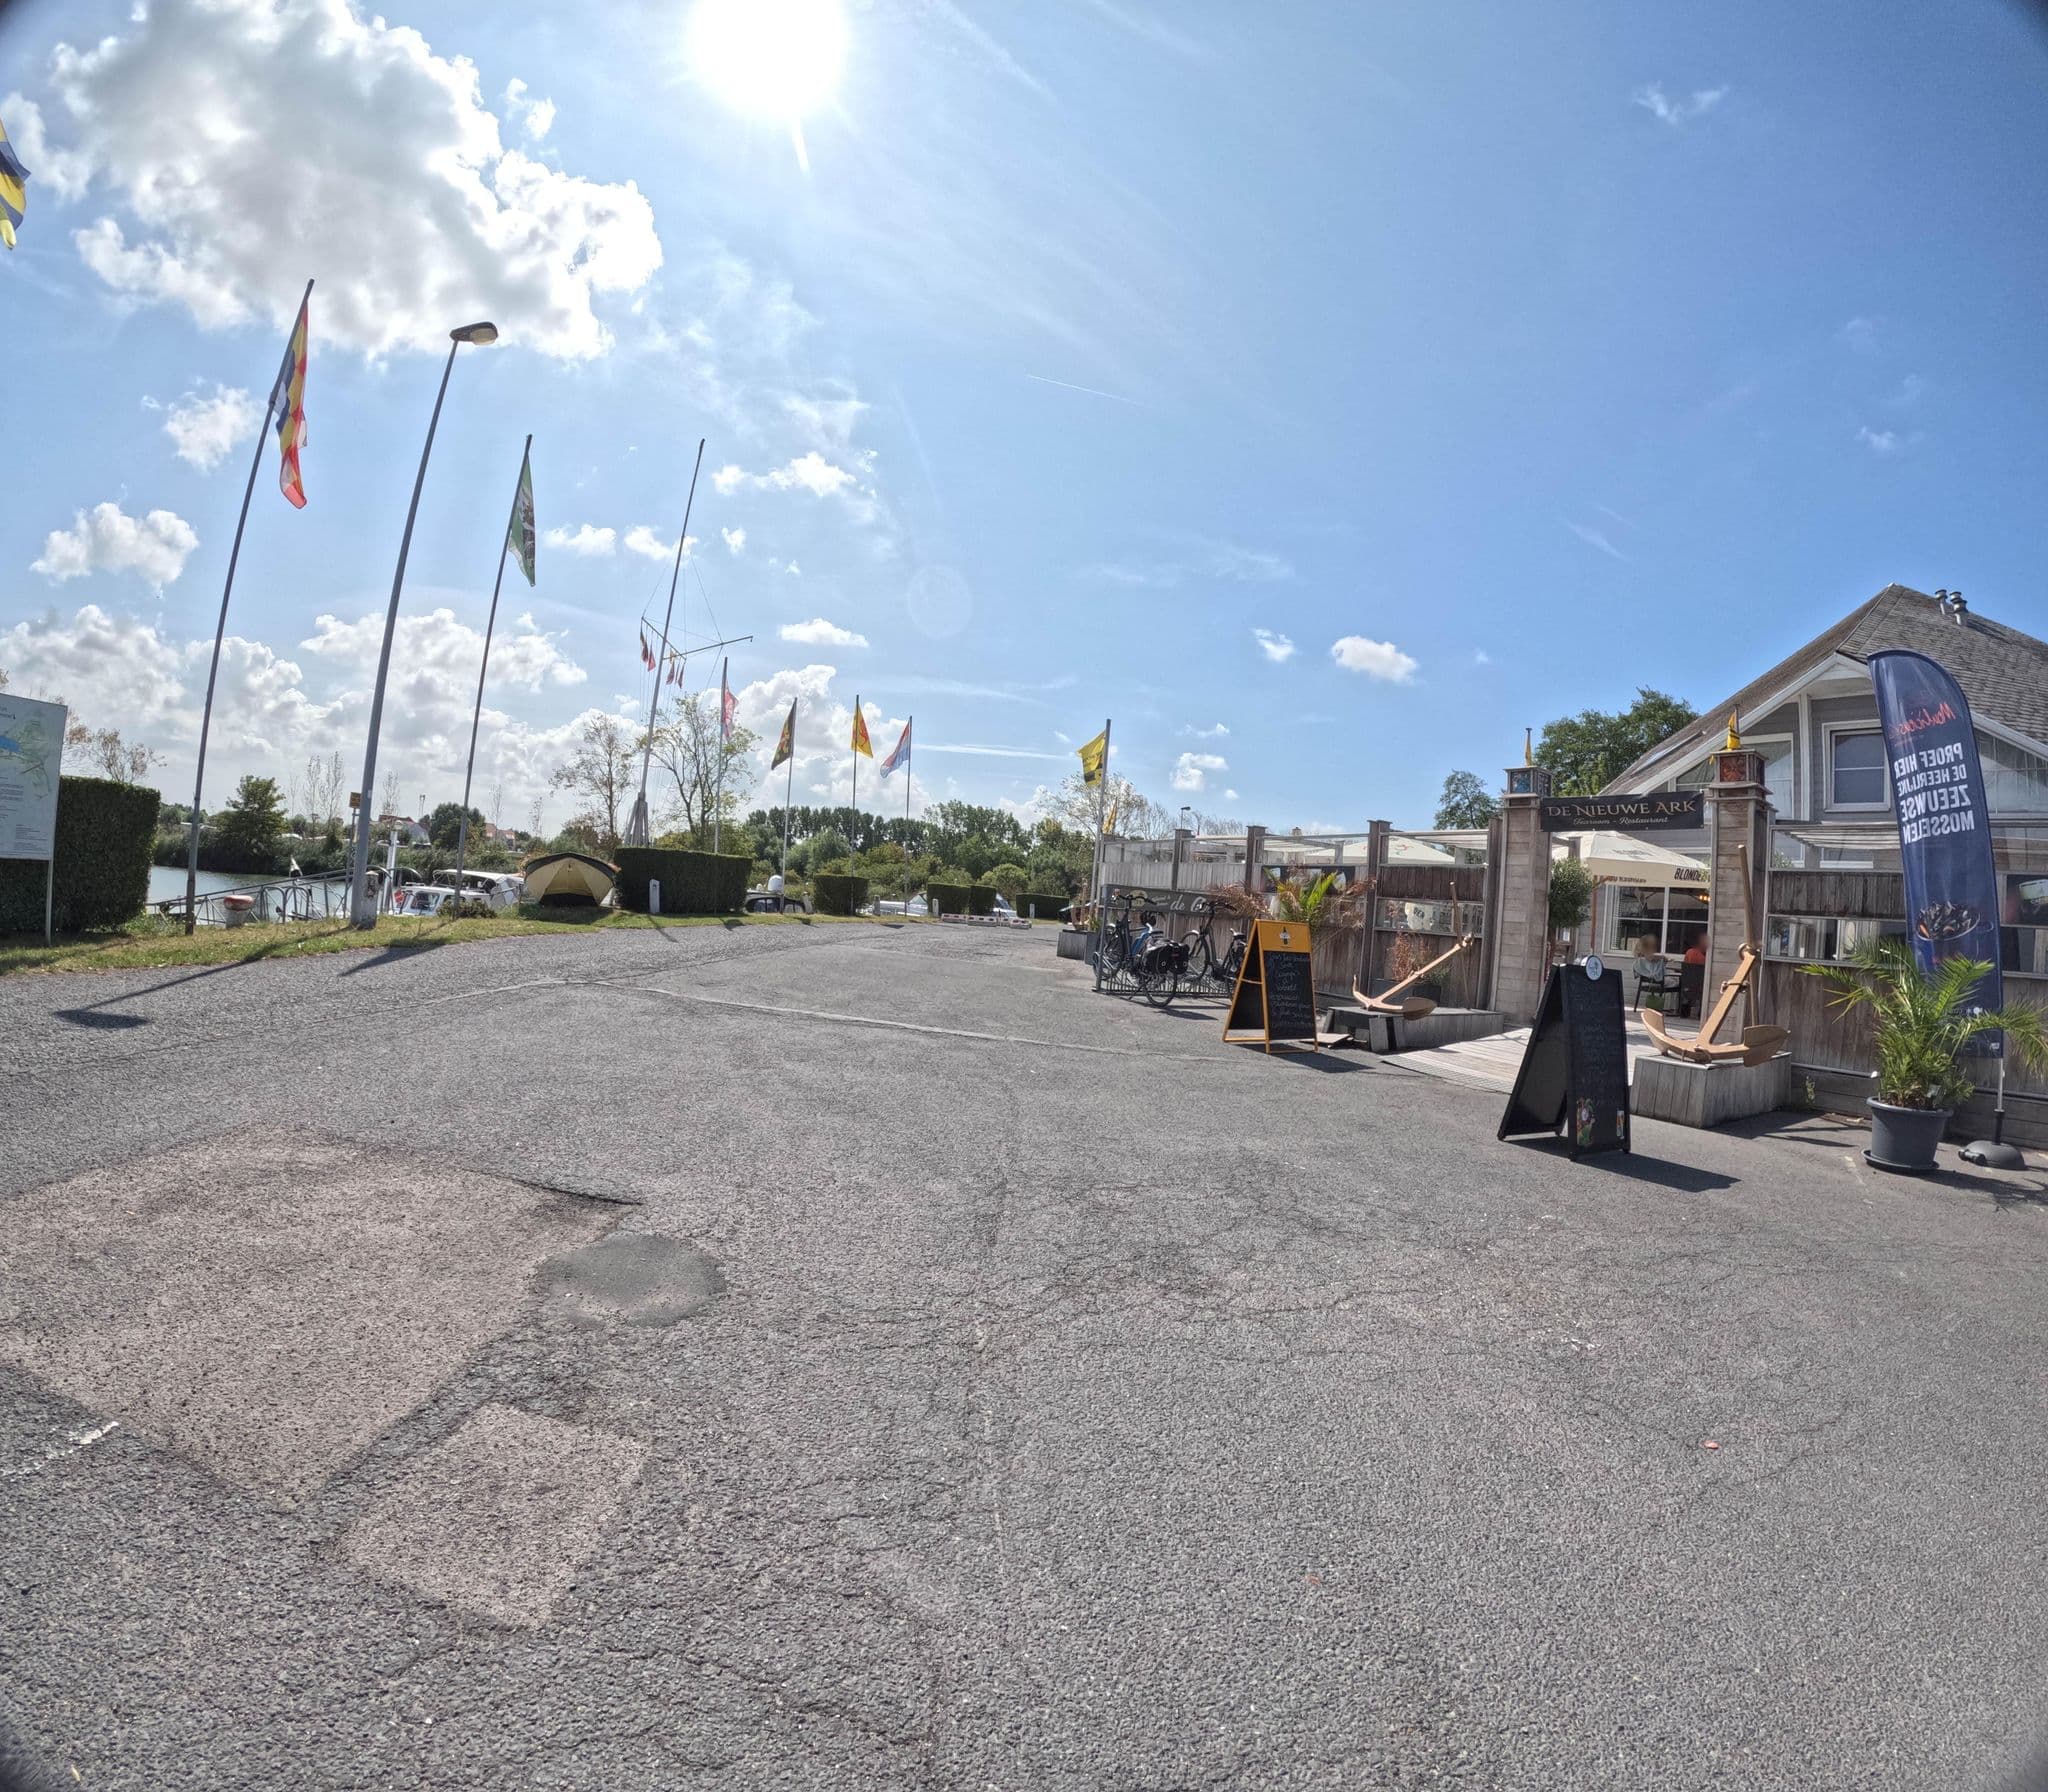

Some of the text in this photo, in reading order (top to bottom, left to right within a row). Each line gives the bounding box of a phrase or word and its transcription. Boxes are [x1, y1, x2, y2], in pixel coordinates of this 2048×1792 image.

[1546, 800, 1697, 818] DE NIEUWE ARK
[1619, 816, 1669, 826] Restaurant
